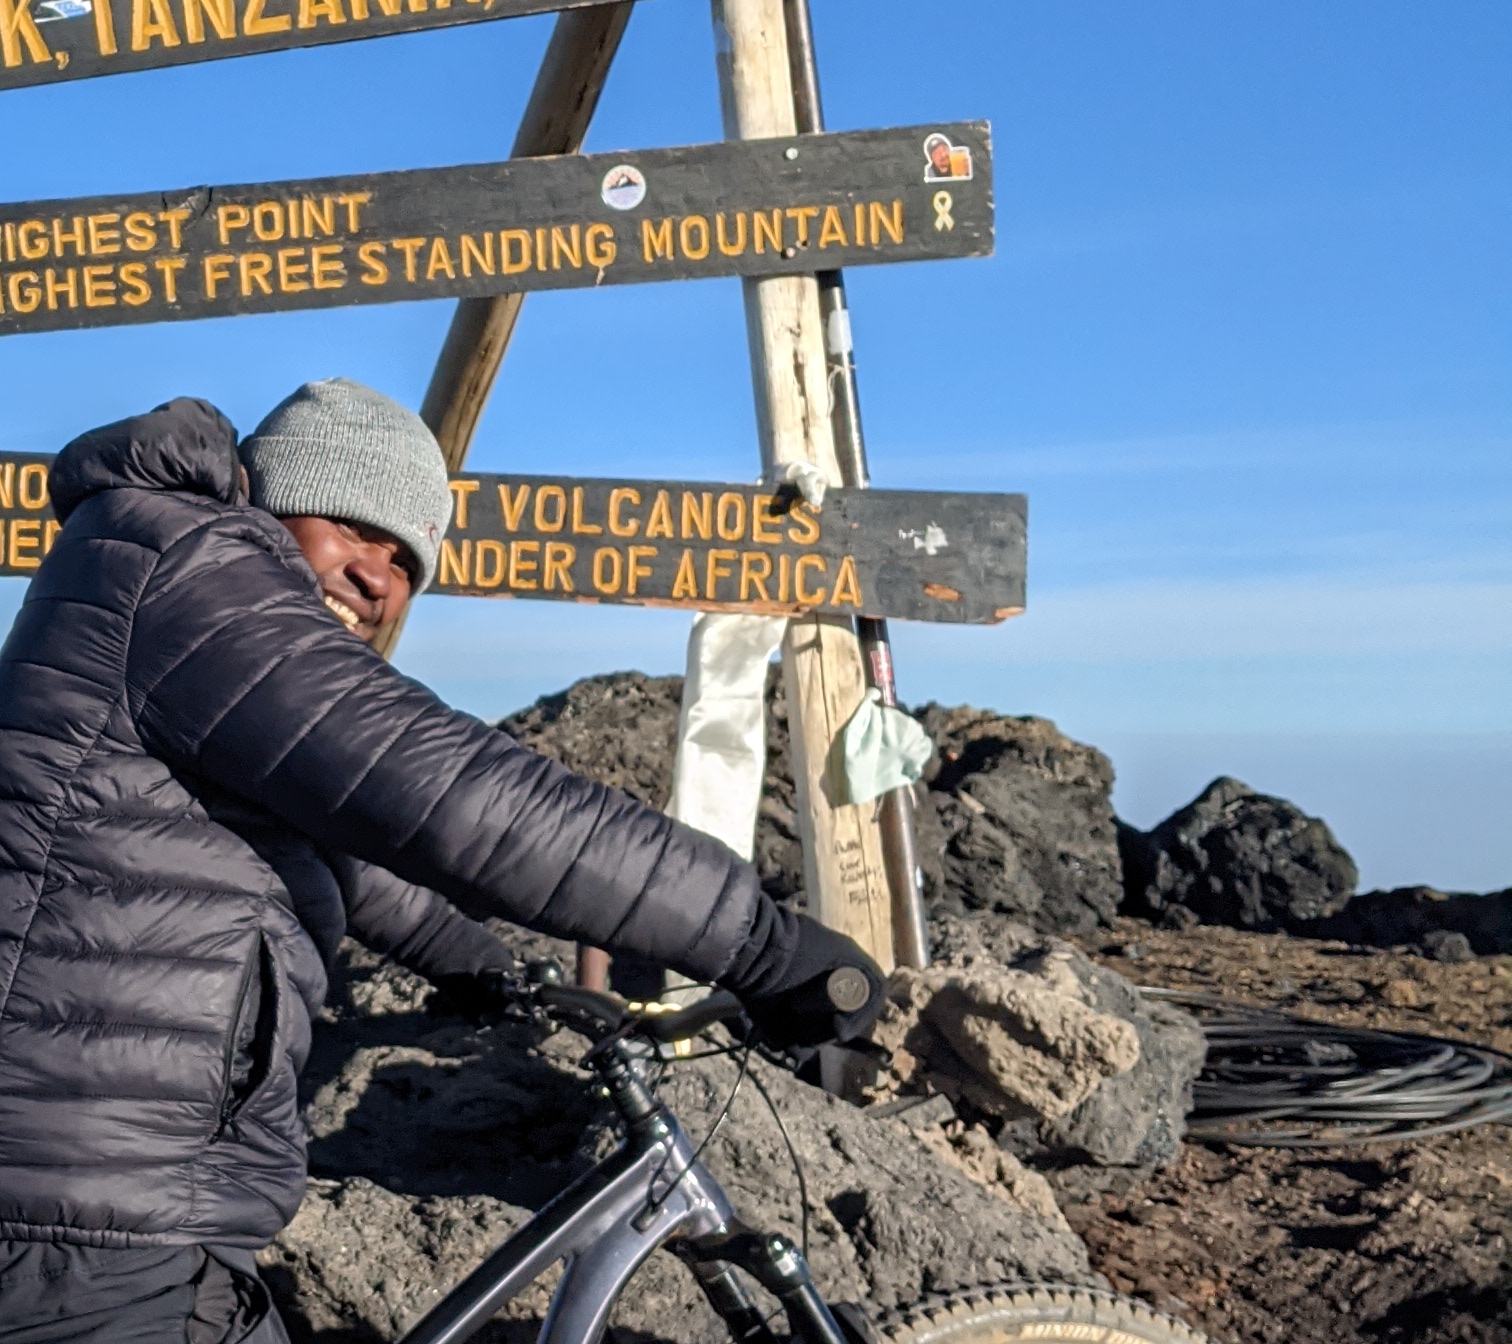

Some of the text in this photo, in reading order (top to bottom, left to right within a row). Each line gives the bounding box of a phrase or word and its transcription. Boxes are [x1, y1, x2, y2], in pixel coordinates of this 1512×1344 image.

[203, 245, 342, 298] FREE
[358, 223, 616, 285] STANDING
[642, 201, 903, 263] MOUNTAIN
[219, 193, 368, 244] POINT
[500, 486, 820, 545] VOLCANOES
[440, 540, 863, 609] NDER OF AFRICA
